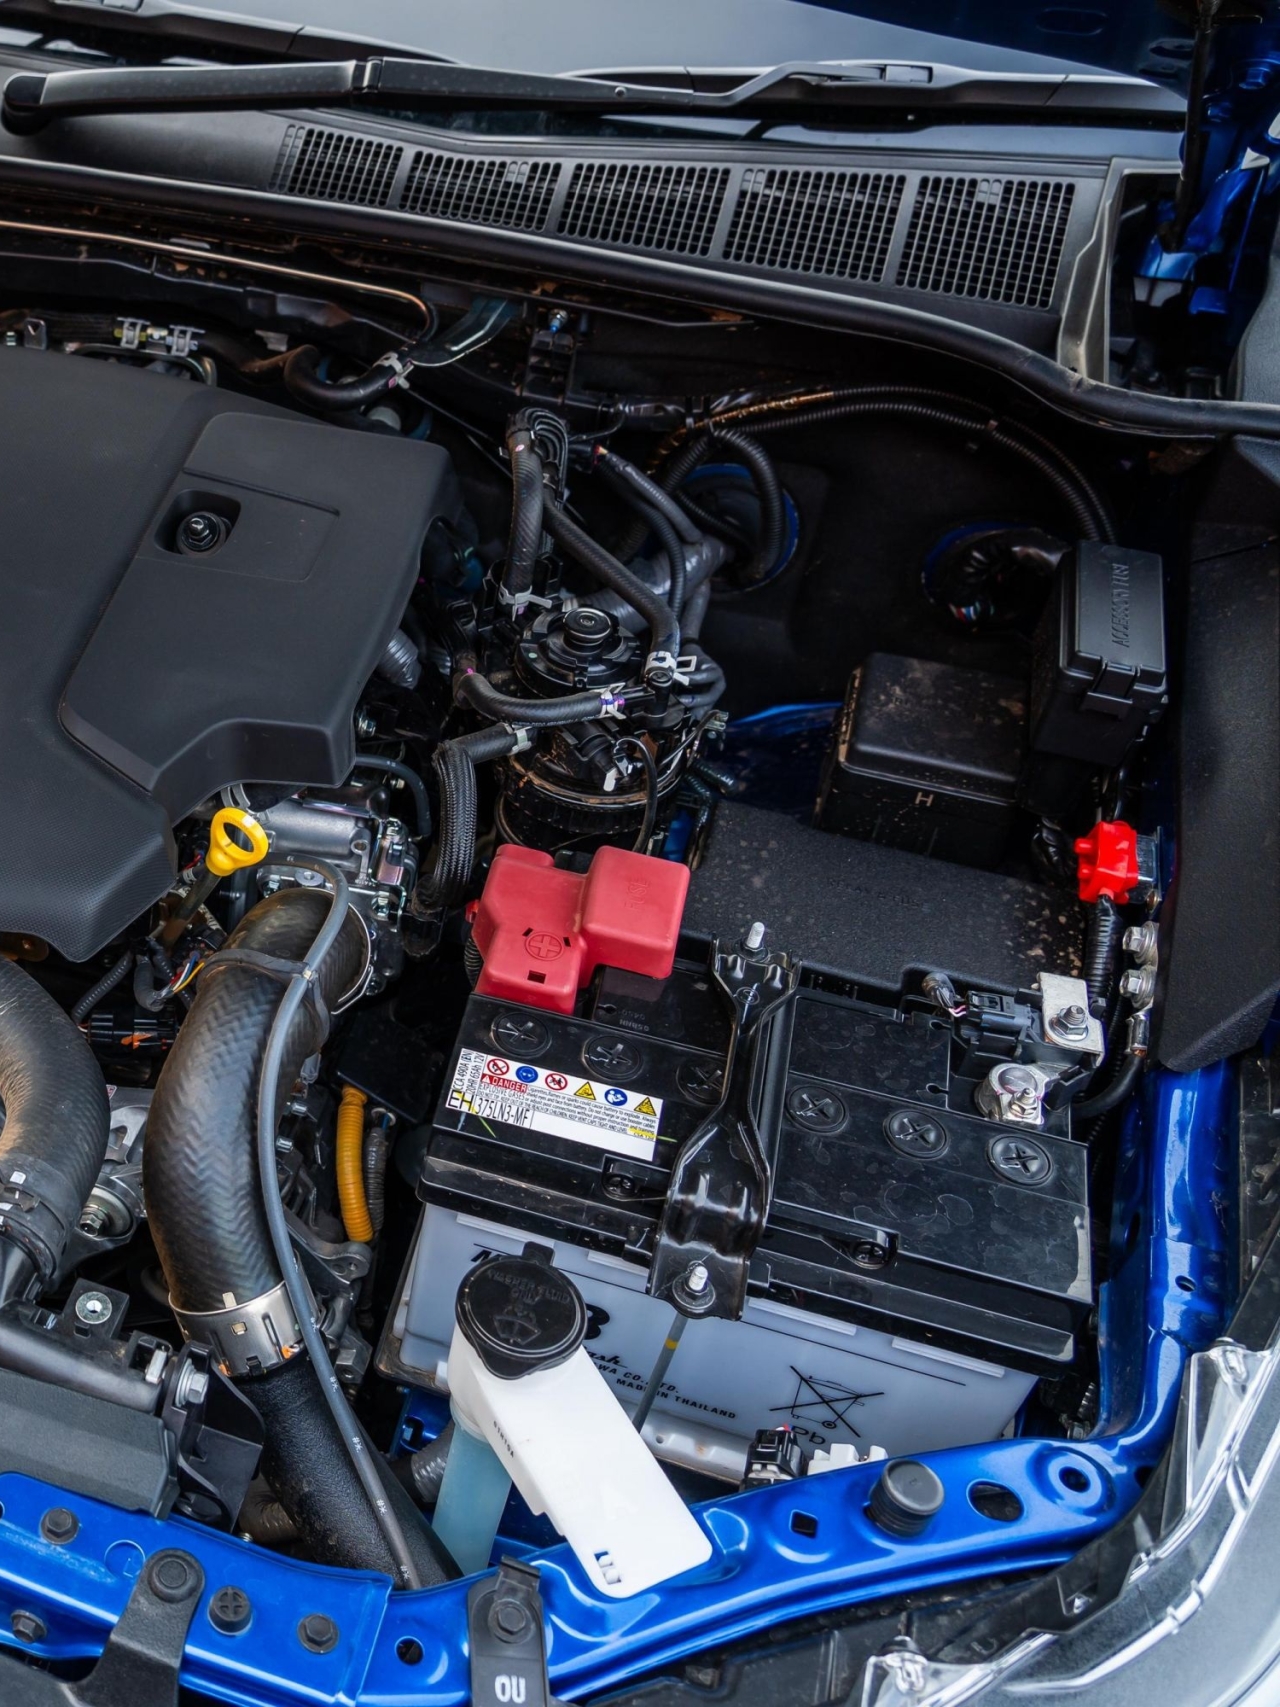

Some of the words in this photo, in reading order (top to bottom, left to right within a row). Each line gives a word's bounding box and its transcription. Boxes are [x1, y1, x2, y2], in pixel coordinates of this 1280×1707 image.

[491, 1076, 527, 1092] DANGER
[616, 1378, 648, 1392] MAD
[675, 1395, 736, 1419] THAILAND
